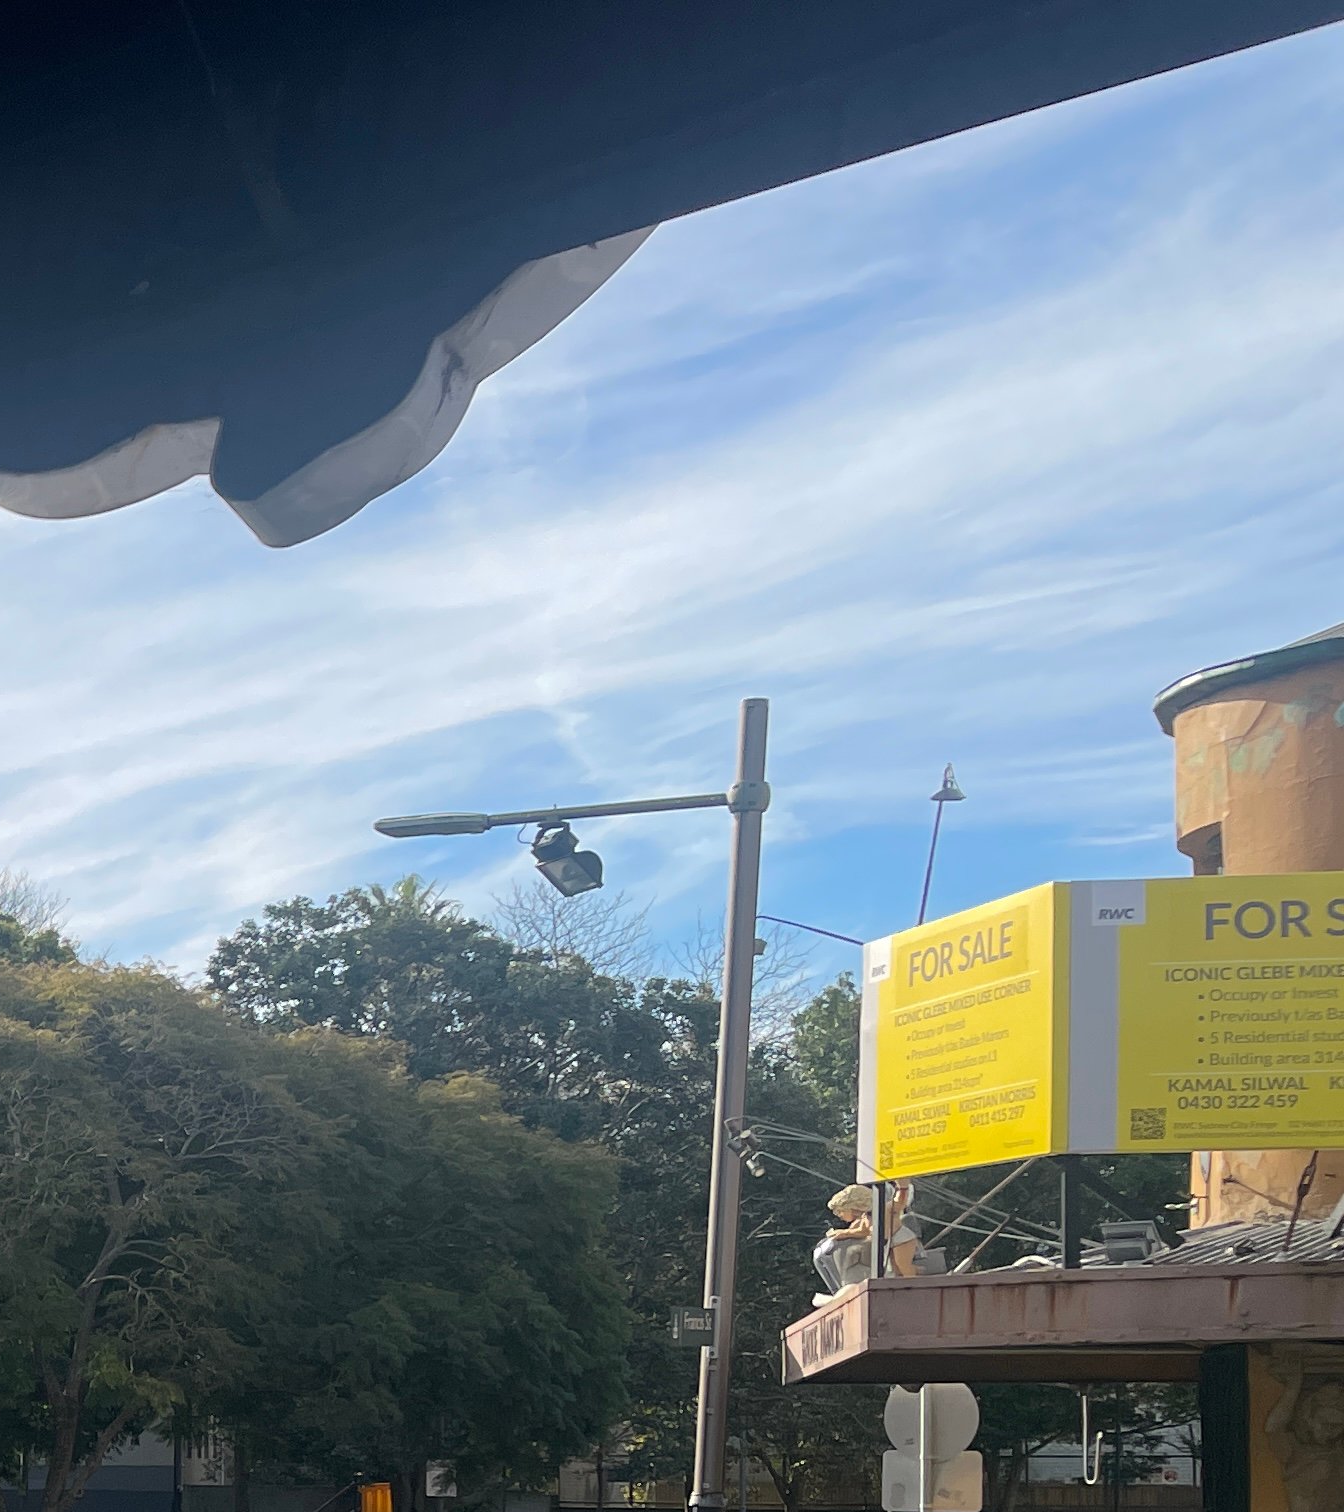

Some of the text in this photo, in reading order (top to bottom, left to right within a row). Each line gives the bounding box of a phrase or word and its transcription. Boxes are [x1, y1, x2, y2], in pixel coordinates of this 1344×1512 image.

[1098, 907, 1135, 921] RWC
[1204, 899, 1312, 941] FOR
[908, 920, 1014, 987] FOR SALE
[1165, 965, 1233, 982] ICONIC
[1236, 964, 1294, 980] GLEBE
[993, 978, 1032, 1000] CORNER
[1209, 986, 1339, 1004] Occupy or Invest
[1210, 1008, 1290, 1024] Previously
[1223, 1029, 1309, 1044] Residential
[1208, 1052, 1273, 1068] Building
[1275, 1053, 1310, 1064] area
[1167, 1075, 1310, 1093] KAMAL SILWAL
[1177, 1093, 1299, 1110] 0430 322 459
[894, 1106, 921, 1126] KAMAL
